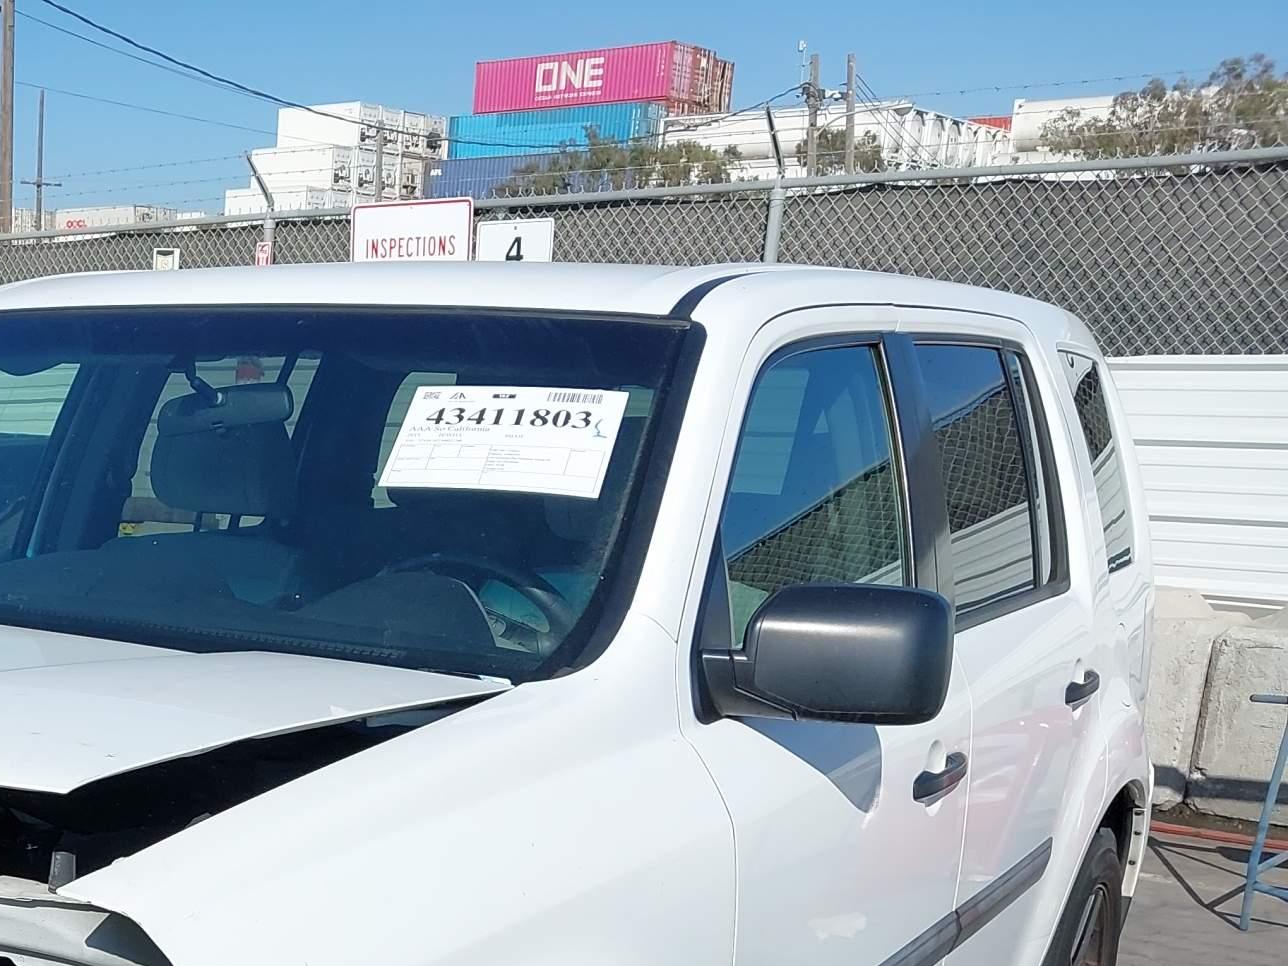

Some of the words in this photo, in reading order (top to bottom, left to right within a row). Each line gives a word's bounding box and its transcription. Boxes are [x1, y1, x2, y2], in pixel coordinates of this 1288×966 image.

[535, 57, 605, 93] ONE
[365, 235, 456, 259] INSPECTIONS
[505, 236, 524, 262] 4
[425, 407, 592, 429] 43411803
